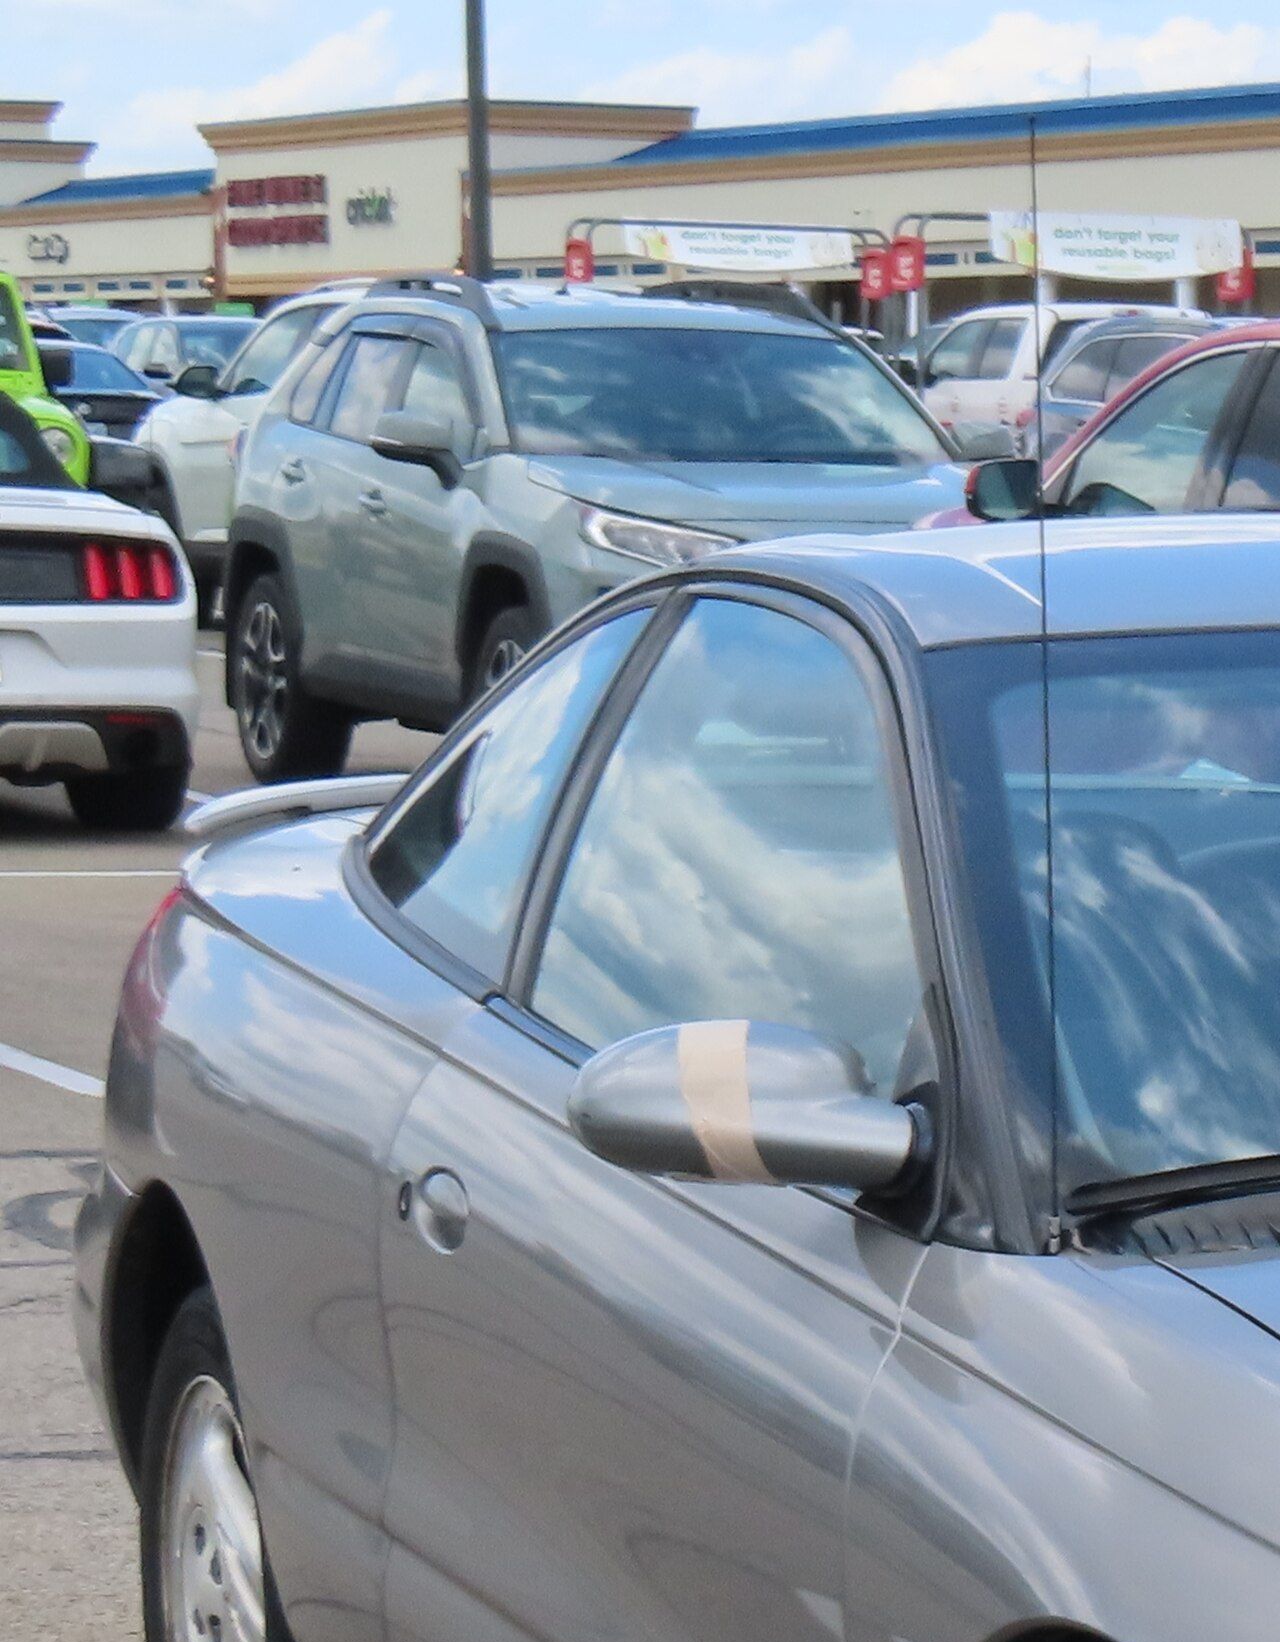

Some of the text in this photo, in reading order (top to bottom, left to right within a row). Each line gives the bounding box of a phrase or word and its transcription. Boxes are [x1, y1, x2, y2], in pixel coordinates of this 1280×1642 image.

[1097, 228, 1142, 245] forget
[1147, 232, 1180, 244] your
[1061, 246, 1128, 258] reusable
